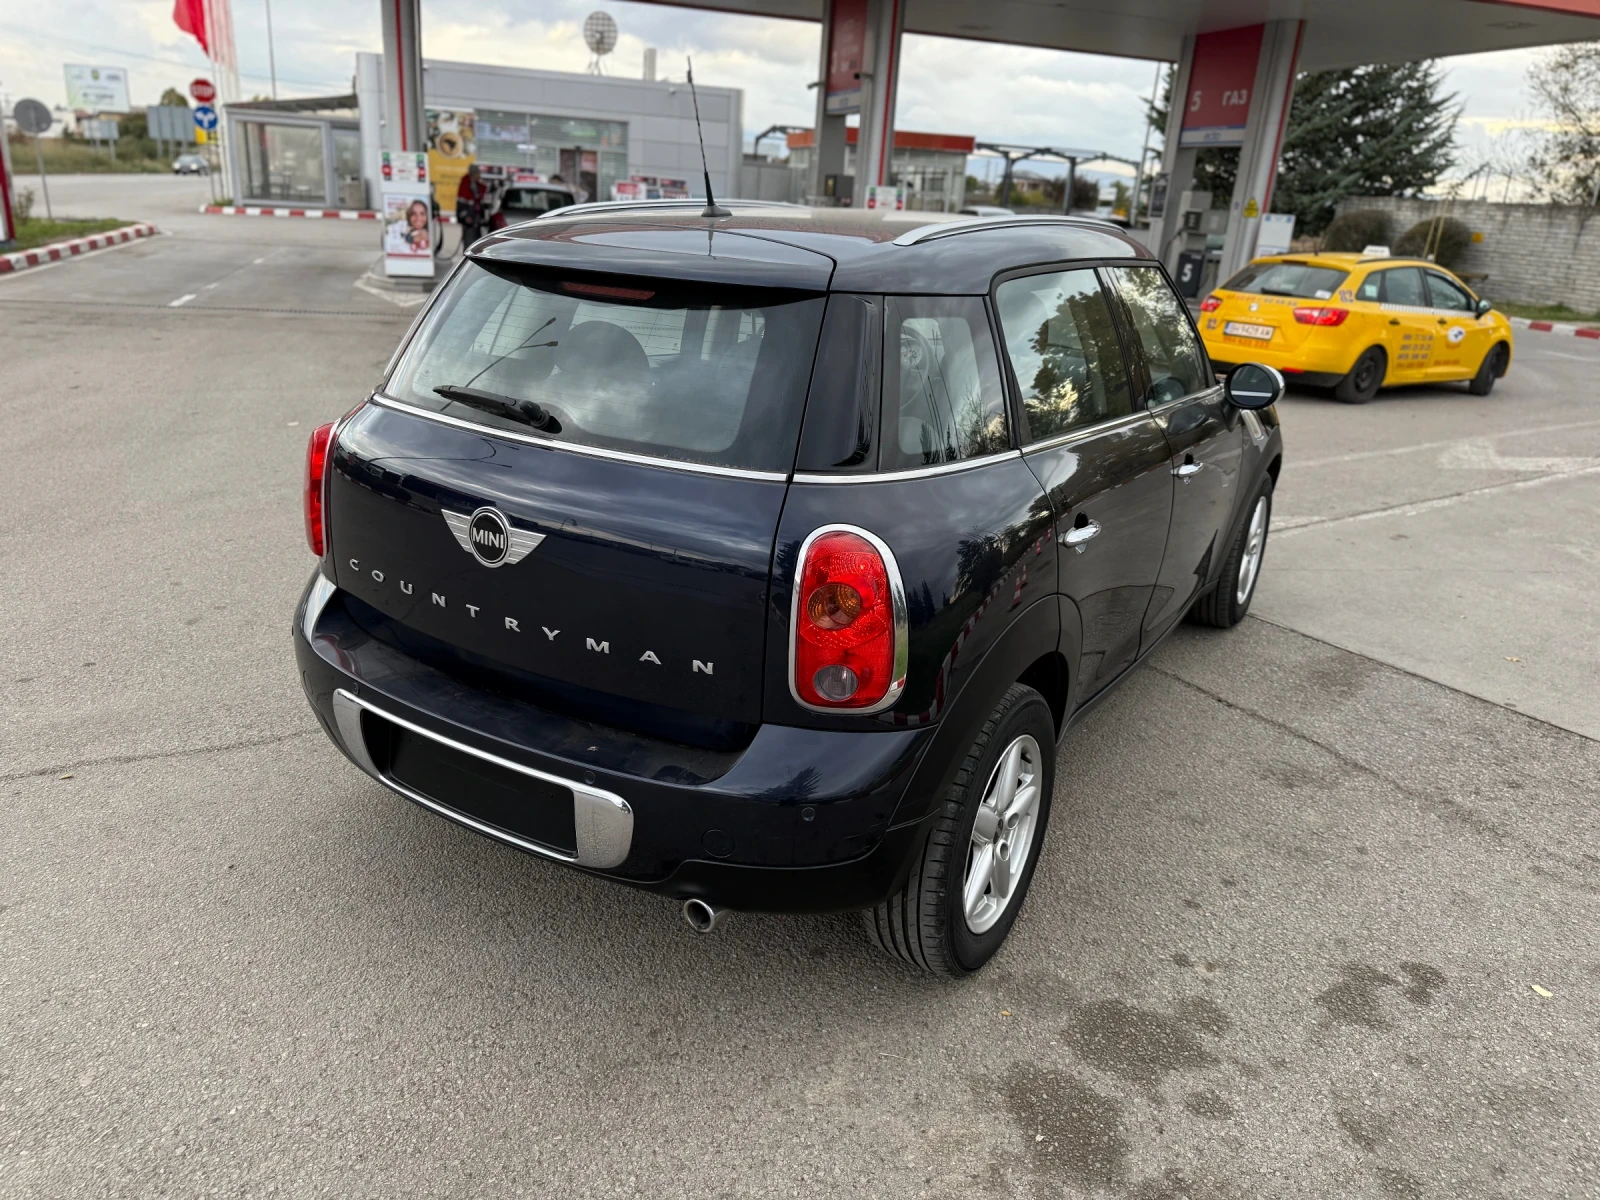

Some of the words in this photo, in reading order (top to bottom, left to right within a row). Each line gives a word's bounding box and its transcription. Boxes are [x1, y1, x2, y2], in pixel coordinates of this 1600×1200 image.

[191, 84, 214, 97] STOP
[1190, 90, 1203, 112] 5
[1222, 88, 1249, 107] ГАЗ
[1181, 263, 1193, 282] 5
[472, 527, 504, 549] MINI
[349, 558, 715, 675] COUNTRYMAN
